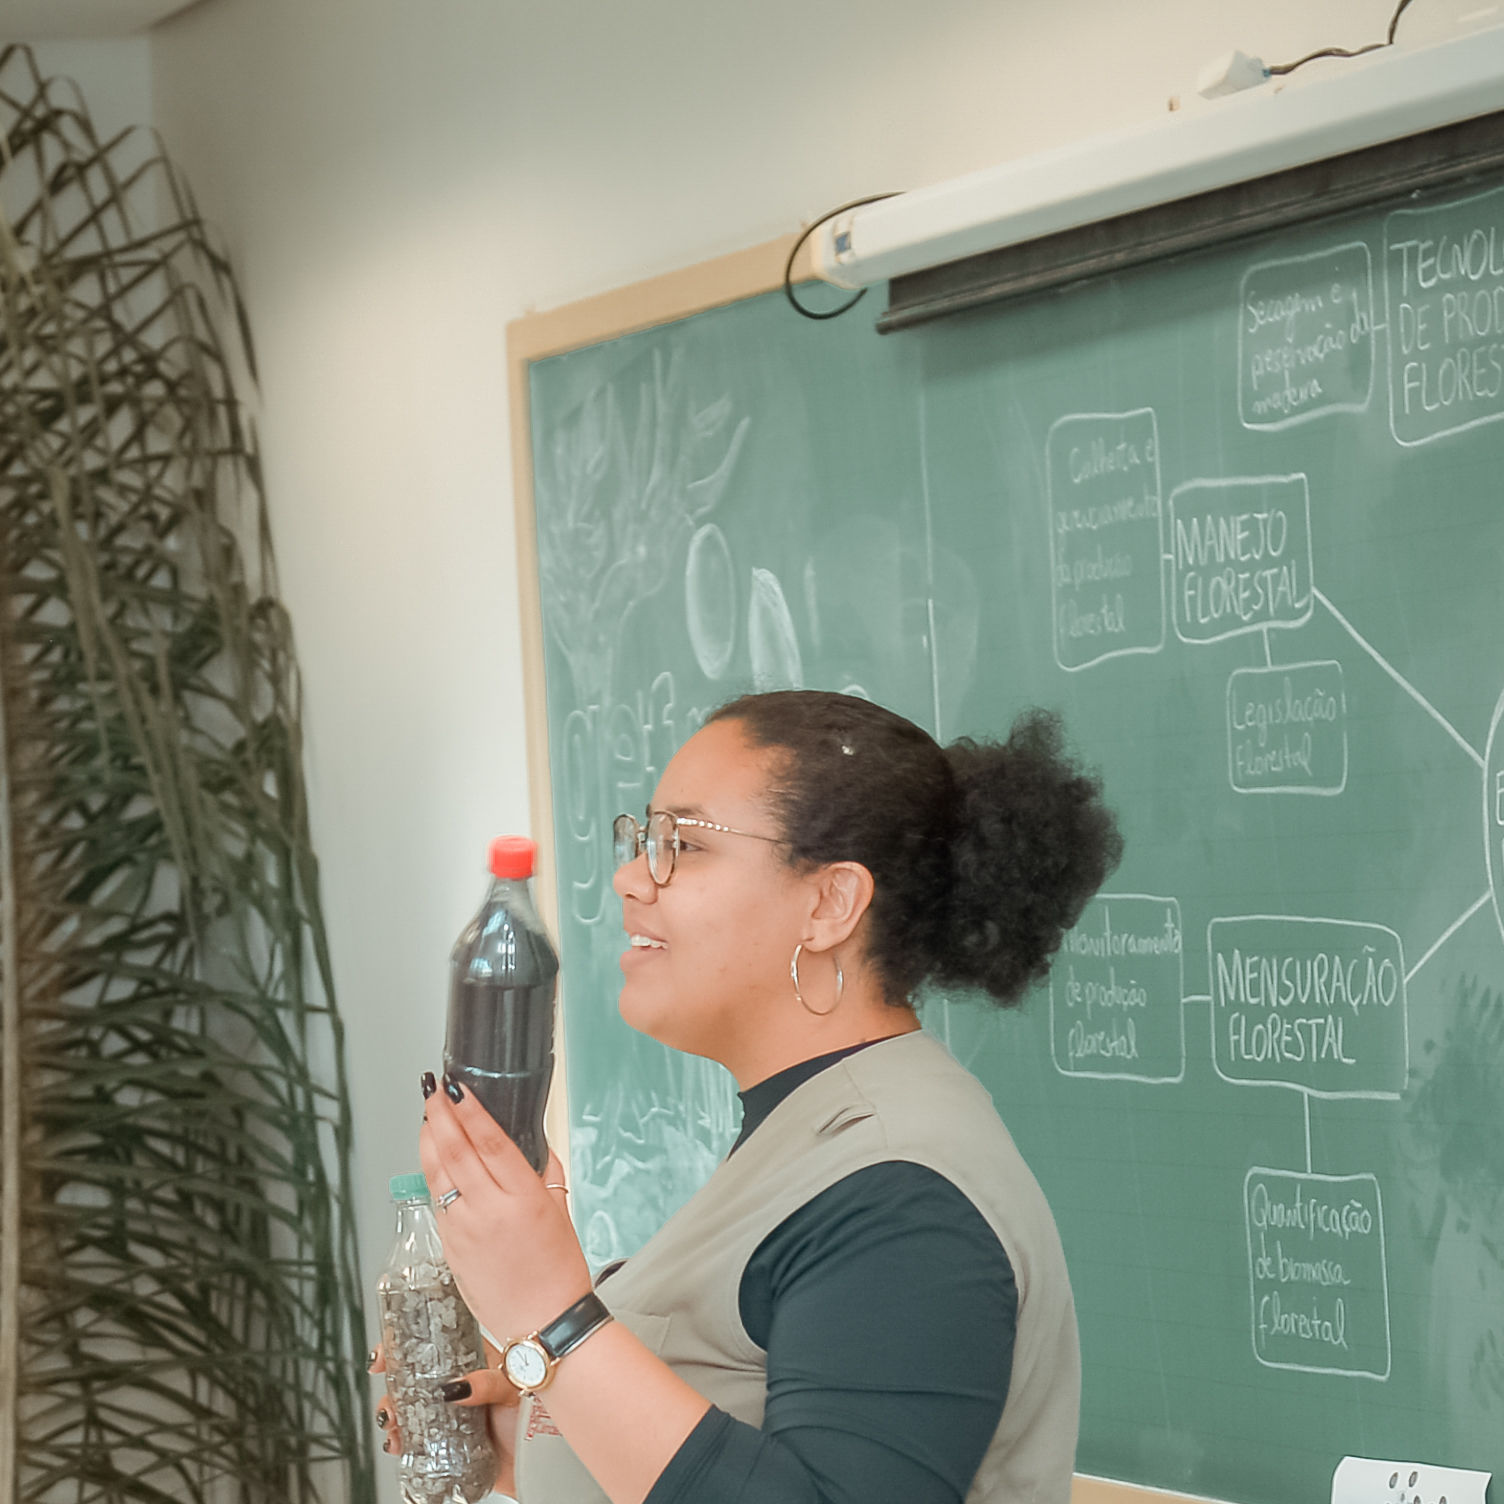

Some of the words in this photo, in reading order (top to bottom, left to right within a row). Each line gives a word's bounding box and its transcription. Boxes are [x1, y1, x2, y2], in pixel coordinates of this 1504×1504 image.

[1400, 303, 1431, 354] DE
[1176, 508, 1287, 569] MANEJO
[1184, 559, 1311, 623] FLORESTAL
[1217, 945, 1398, 1015] MENSURAÇÃO
[1229, 1012, 1356, 1064] FLORESTAL
[1251, 1183, 1371, 1240] Quantificação
[1255, 1231, 1276, 1279] de
[1276, 1240, 1351, 1285] biomassa
